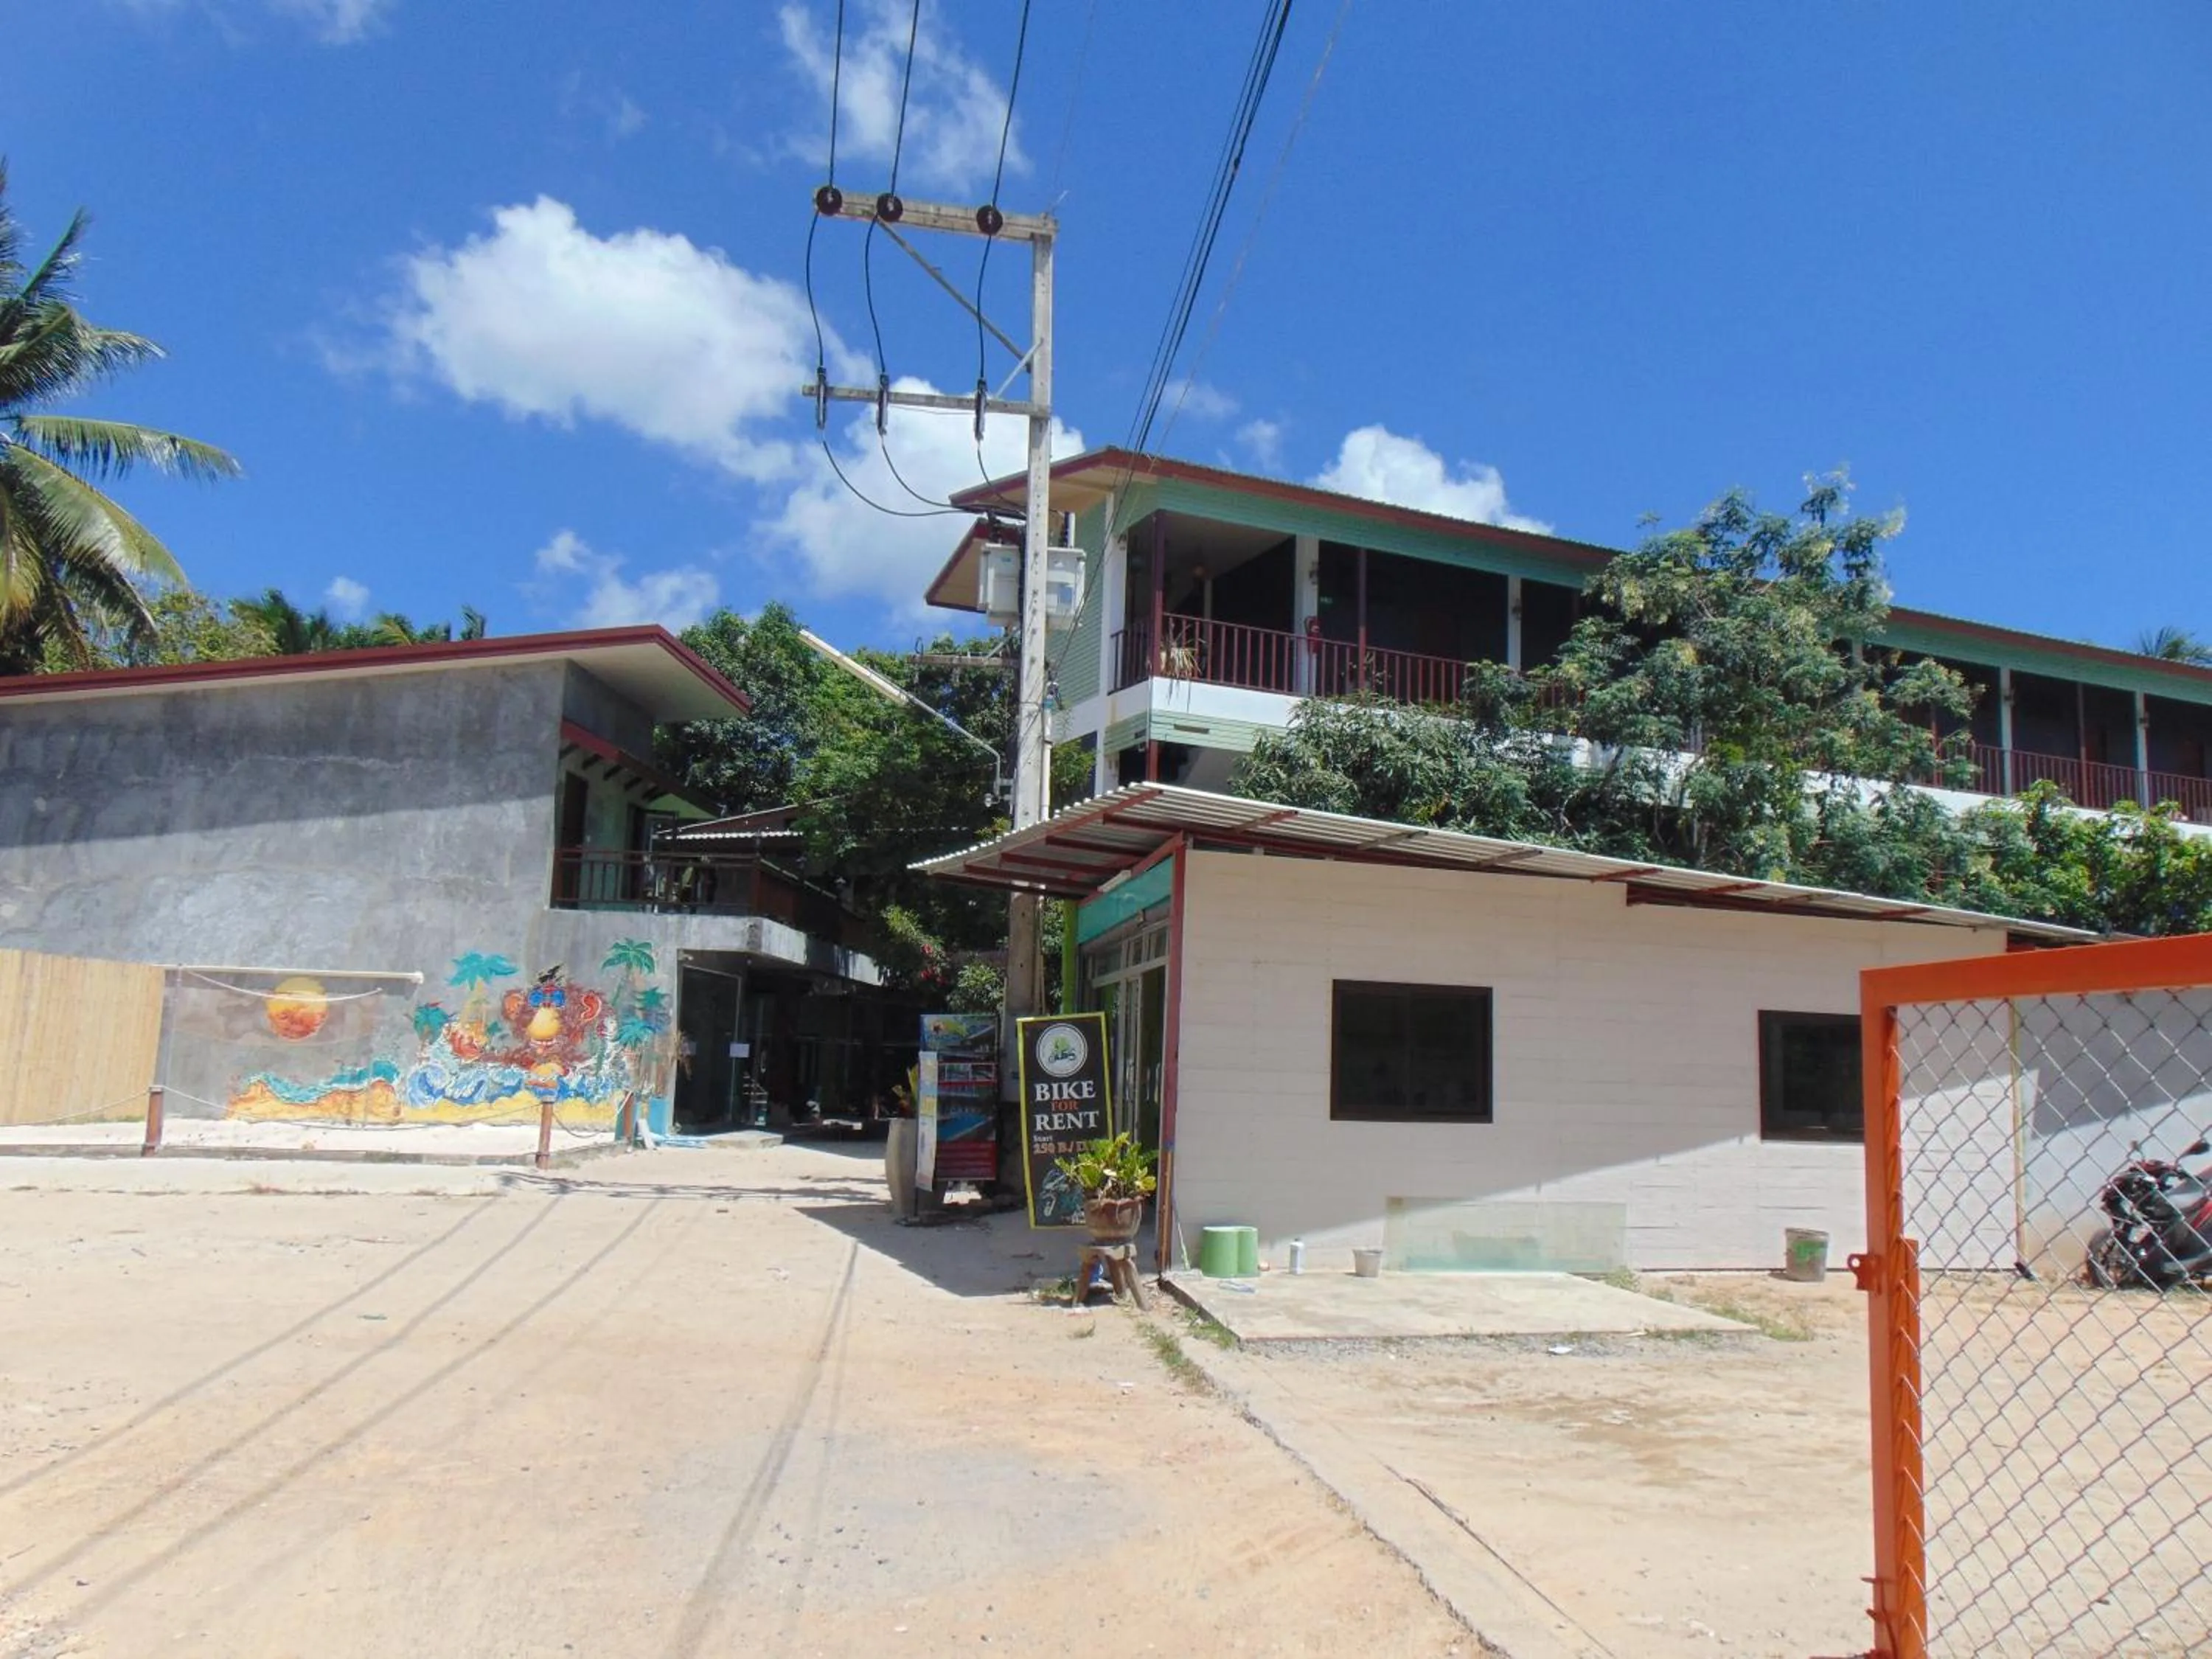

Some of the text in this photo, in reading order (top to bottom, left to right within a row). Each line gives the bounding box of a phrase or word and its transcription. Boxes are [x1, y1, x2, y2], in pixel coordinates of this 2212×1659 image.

[1034, 1081, 1096, 1102] BIKE
[1050, 1099, 1079, 1112] FOR
[1034, 1110, 1099, 1131] RENT
